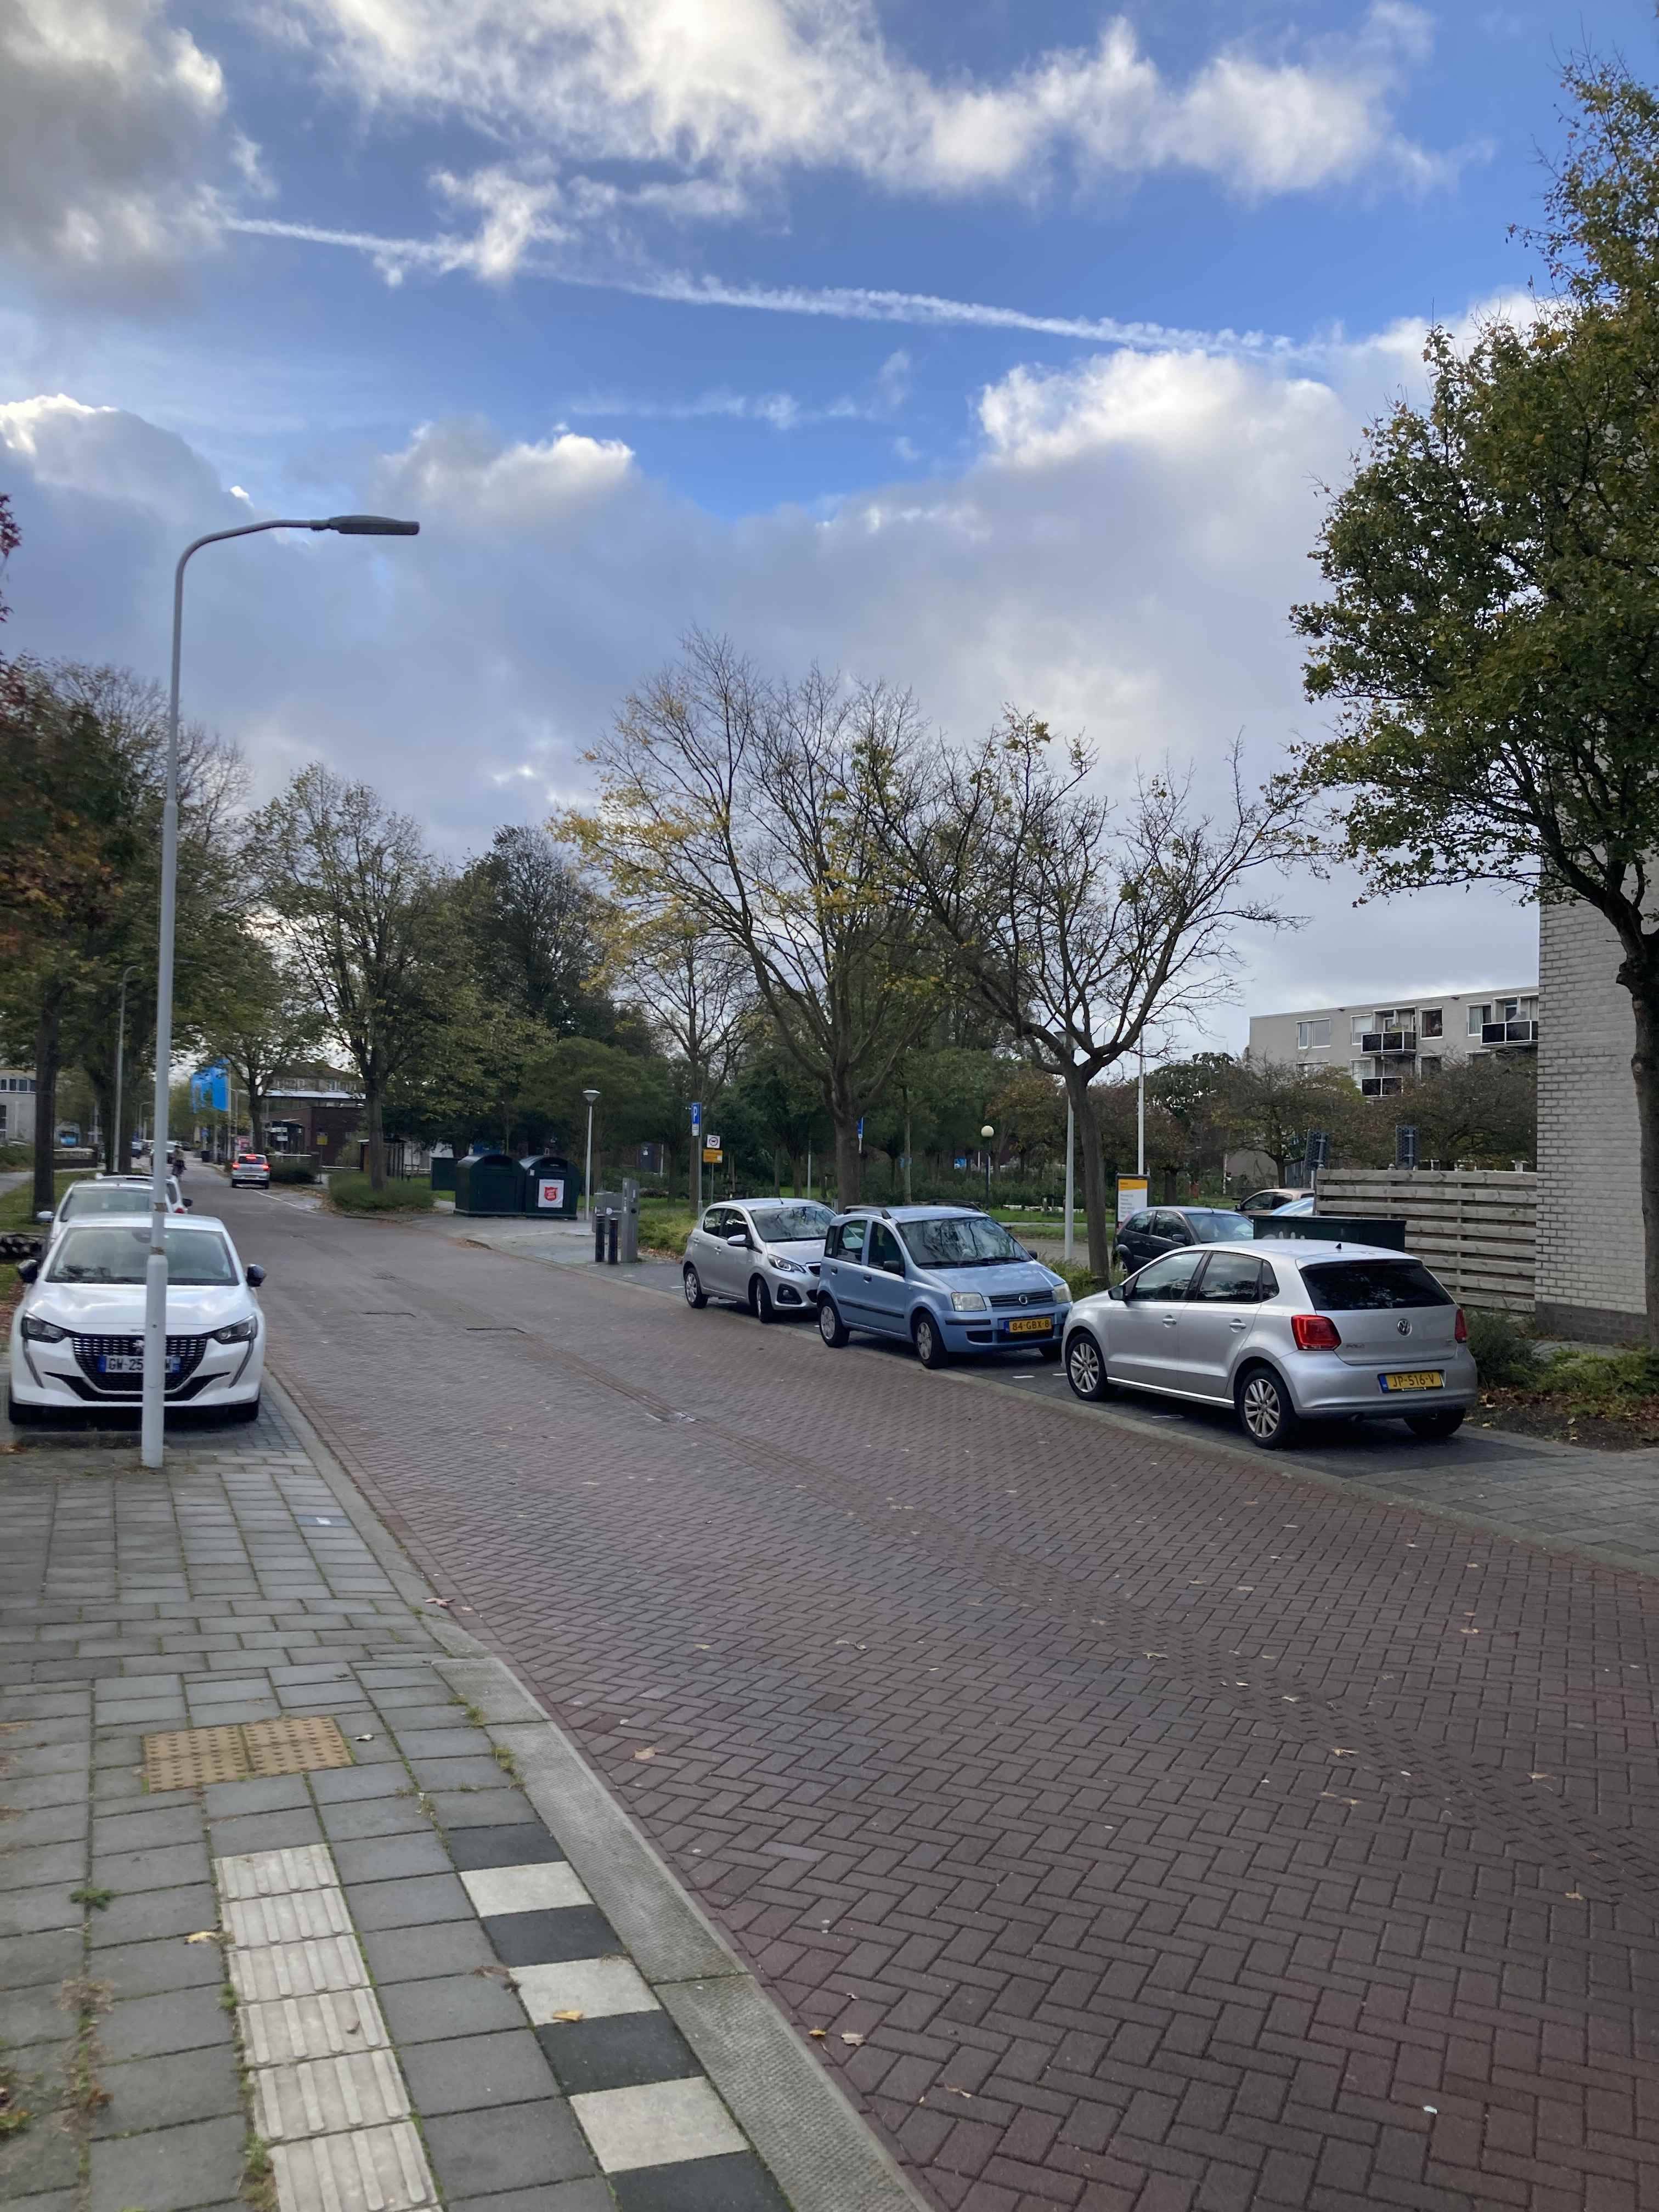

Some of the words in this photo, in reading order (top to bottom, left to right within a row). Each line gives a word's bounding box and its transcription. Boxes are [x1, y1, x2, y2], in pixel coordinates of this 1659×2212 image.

[693, 1106, 697, 1122] P
[1013, 1320, 1049, 1330] 84-GBX-8
[1393, 1374, 1435, 1387] JP-516-V
